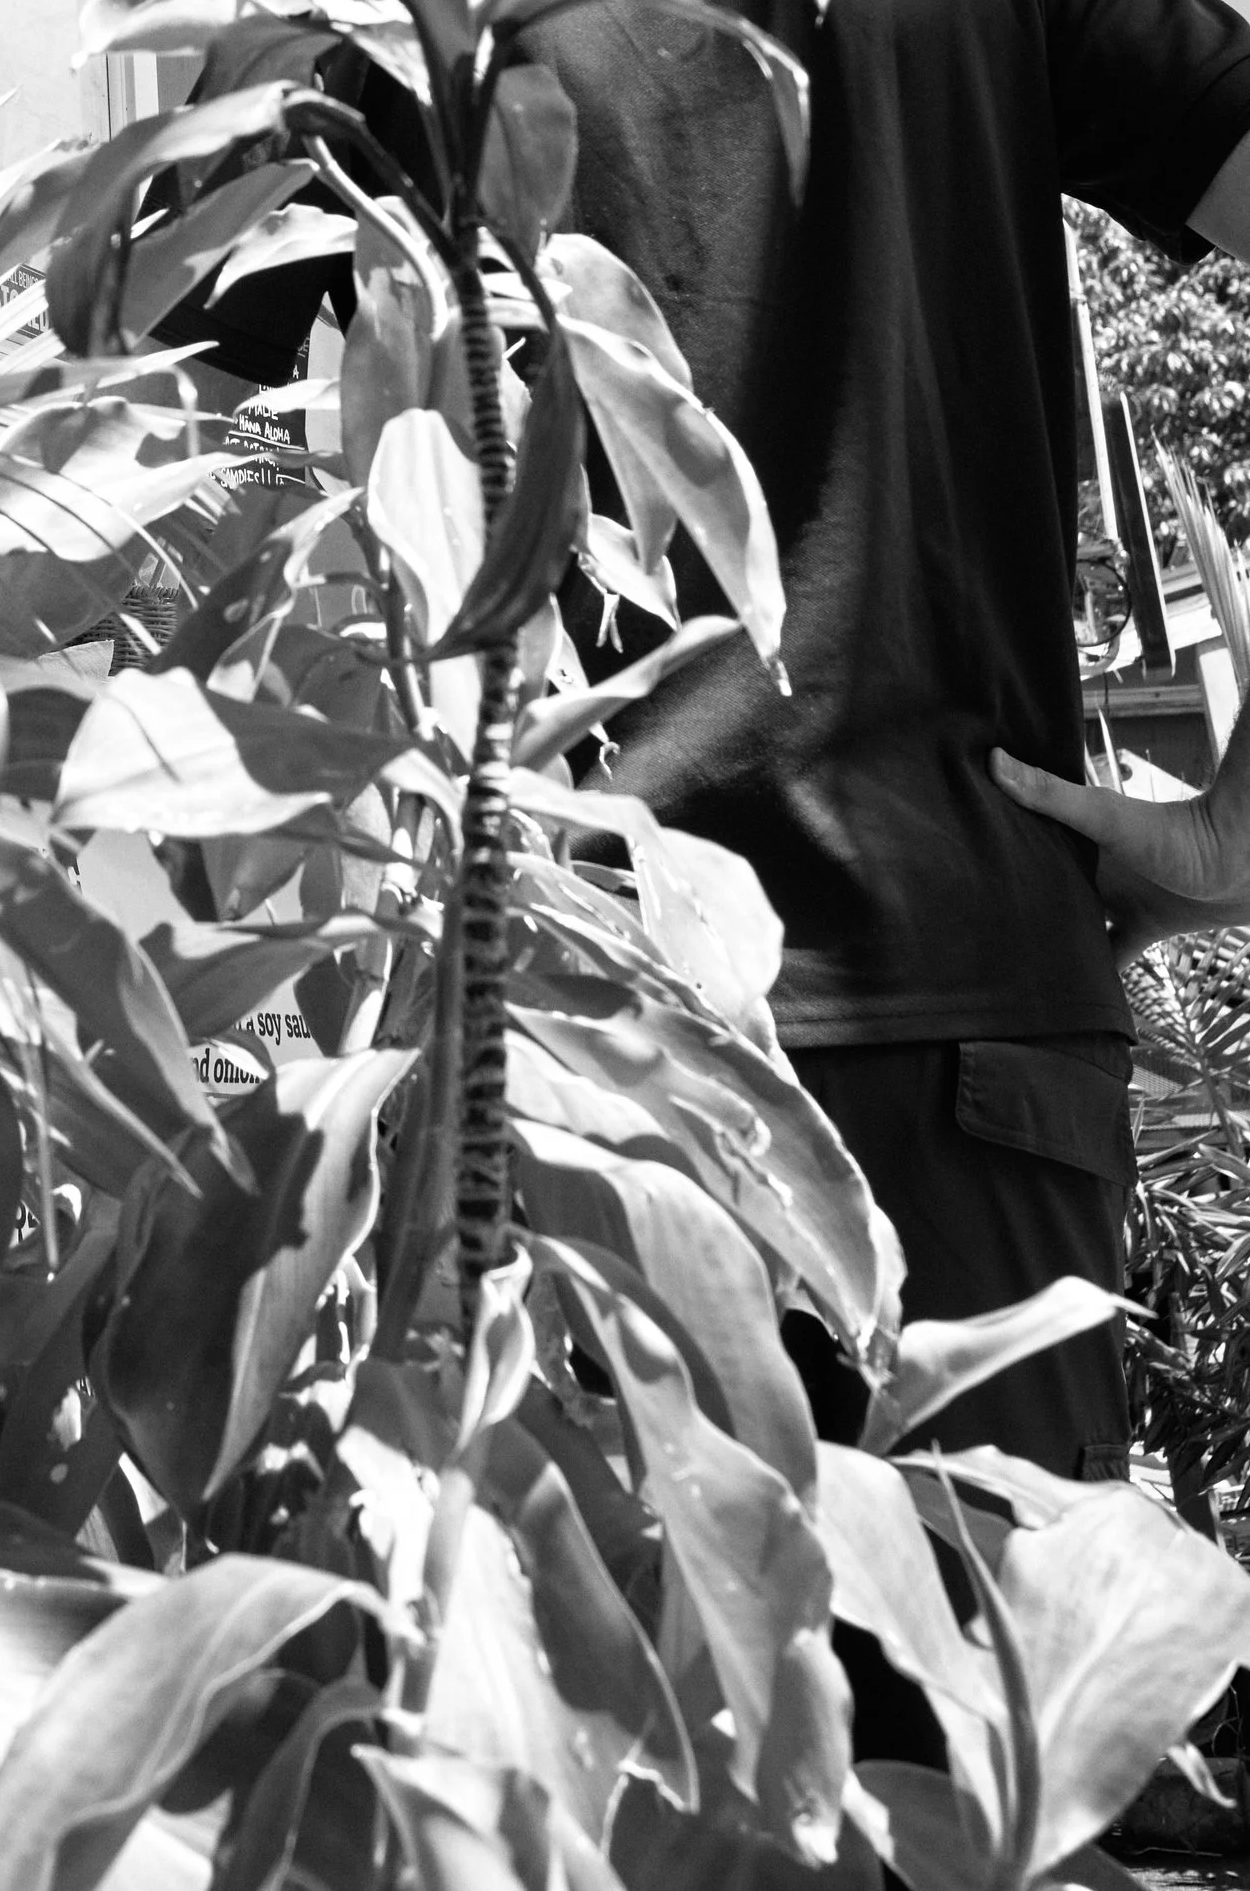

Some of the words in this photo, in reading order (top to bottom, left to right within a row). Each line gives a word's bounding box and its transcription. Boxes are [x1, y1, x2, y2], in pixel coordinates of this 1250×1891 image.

[264, 421, 291, 445] ALOHA
[257, 1012, 281, 1046] soy
[284, 1014, 311, 1039] sau
